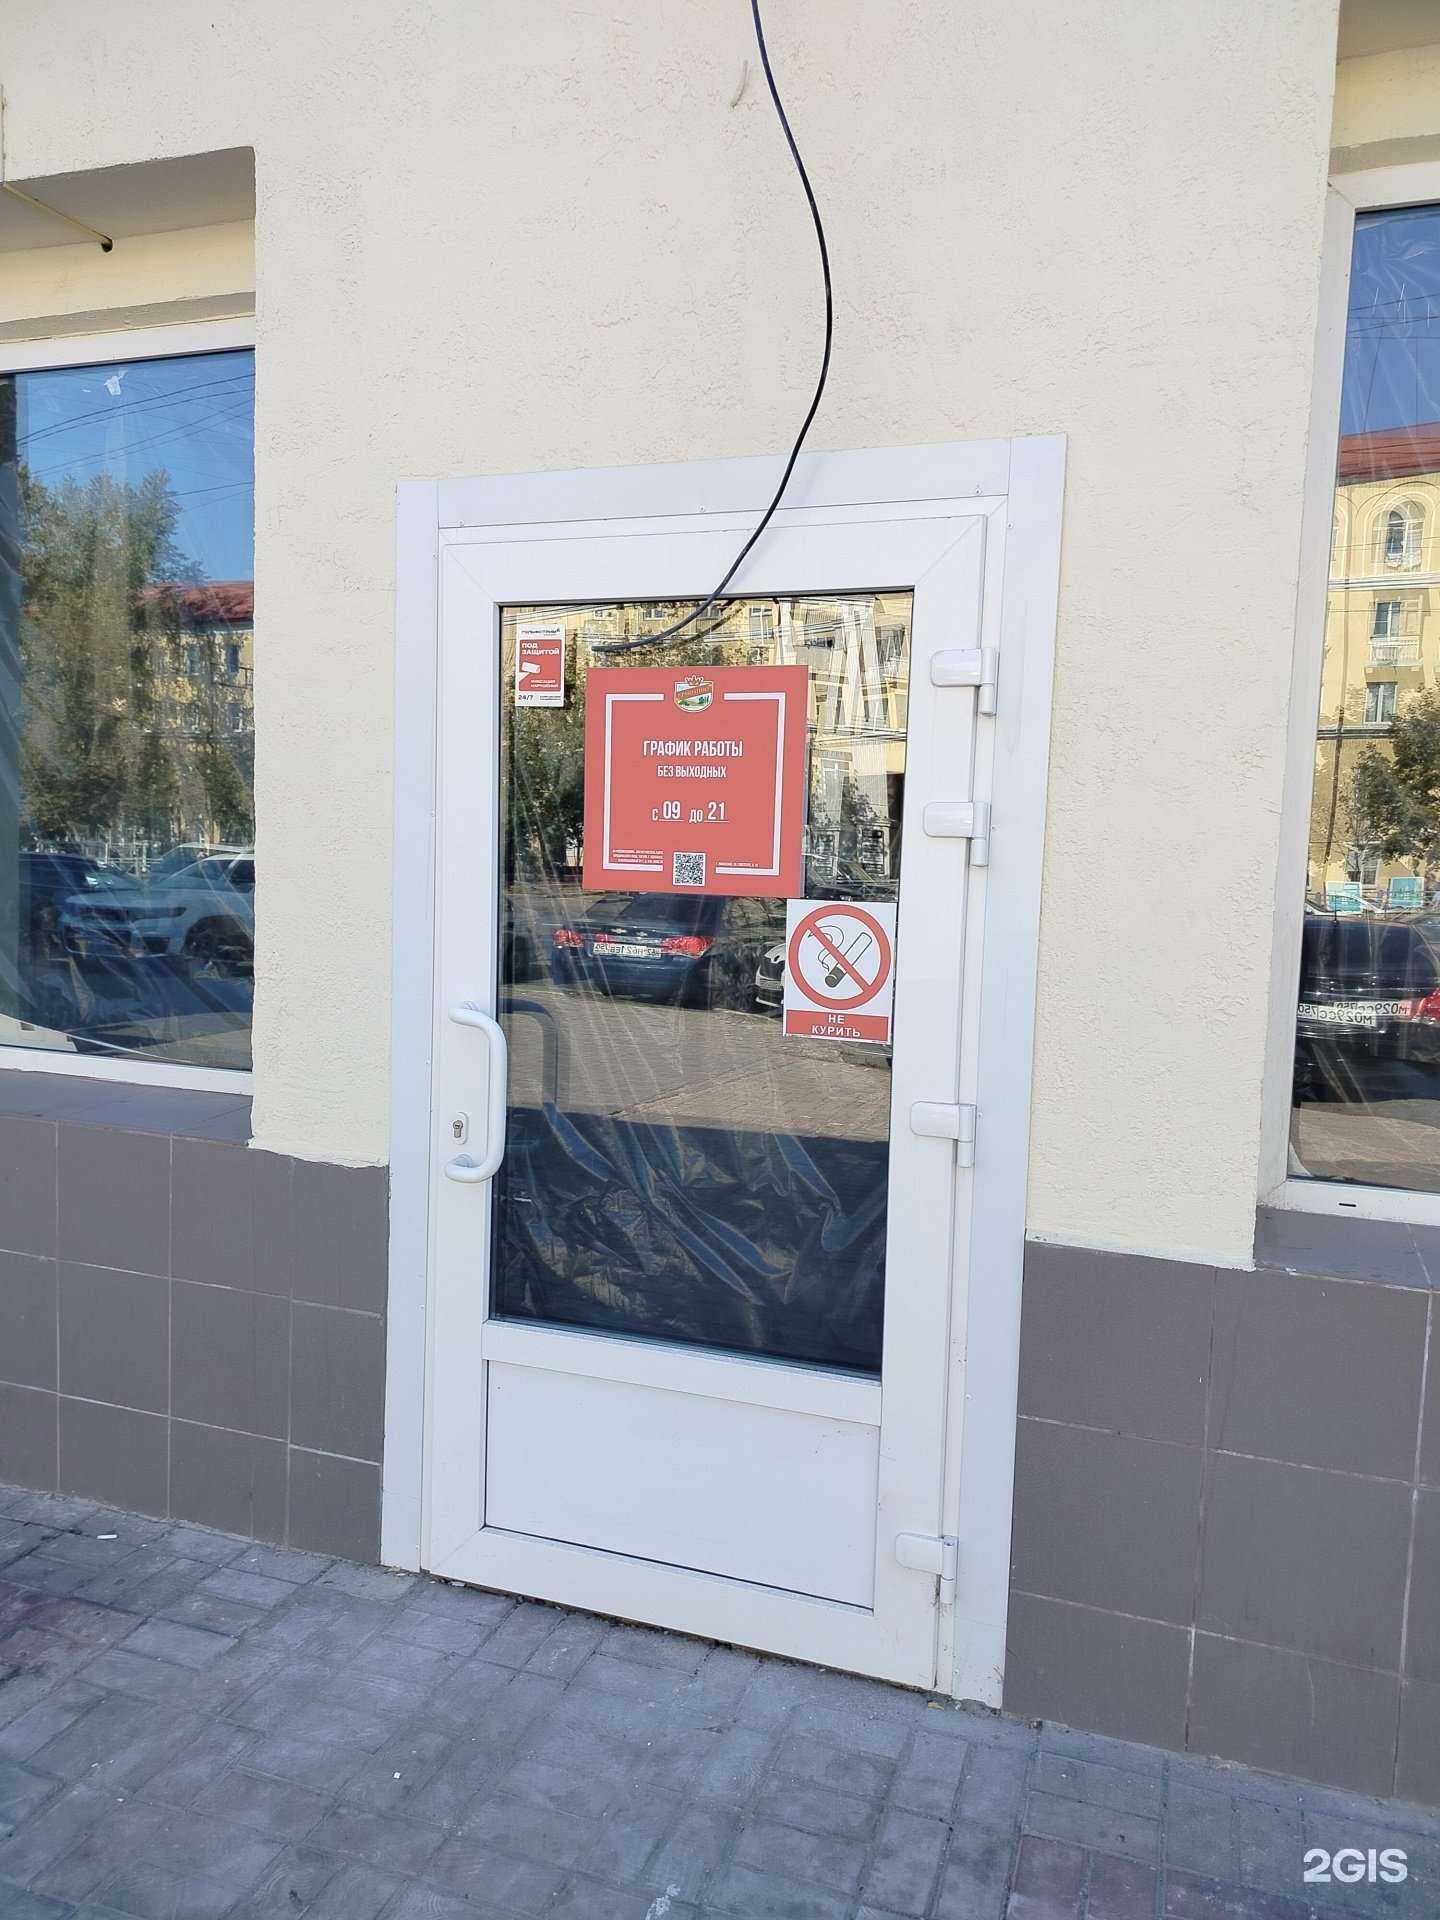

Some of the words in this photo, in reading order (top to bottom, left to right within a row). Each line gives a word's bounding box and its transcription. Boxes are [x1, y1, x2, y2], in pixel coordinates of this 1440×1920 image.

[643, 740, 692, 757] ГРАФИК
[694, 740, 743, 757] РАБОТЫ
[657, 765, 674, 777] БЕЗ
[675, 765, 727, 779] ВЫХОДНЫХ
[662, 801, 681, 820] 09
[707, 801, 726, 820] 21
[828, 1013, 845, 1024] НЕ
[811, 1025, 861, 1038] КУРИТЬ
